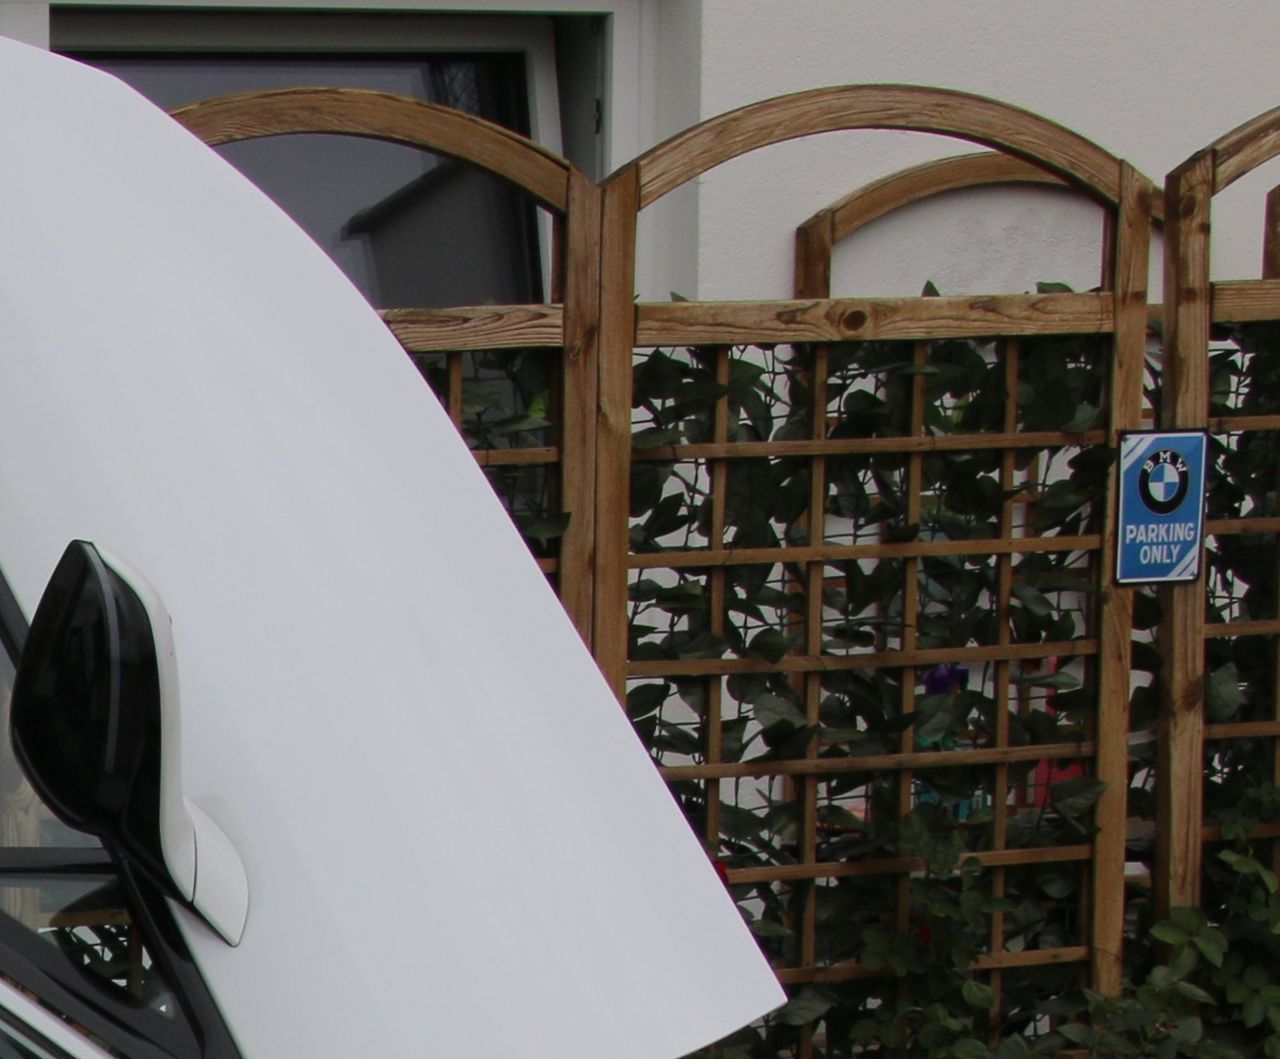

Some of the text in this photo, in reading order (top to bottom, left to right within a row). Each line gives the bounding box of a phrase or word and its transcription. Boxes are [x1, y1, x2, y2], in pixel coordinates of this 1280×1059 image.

[1142, 451, 1187, 474] BMW
[1125, 523, 1195, 544] PARKING
[1139, 544, 1182, 565] ONLY
